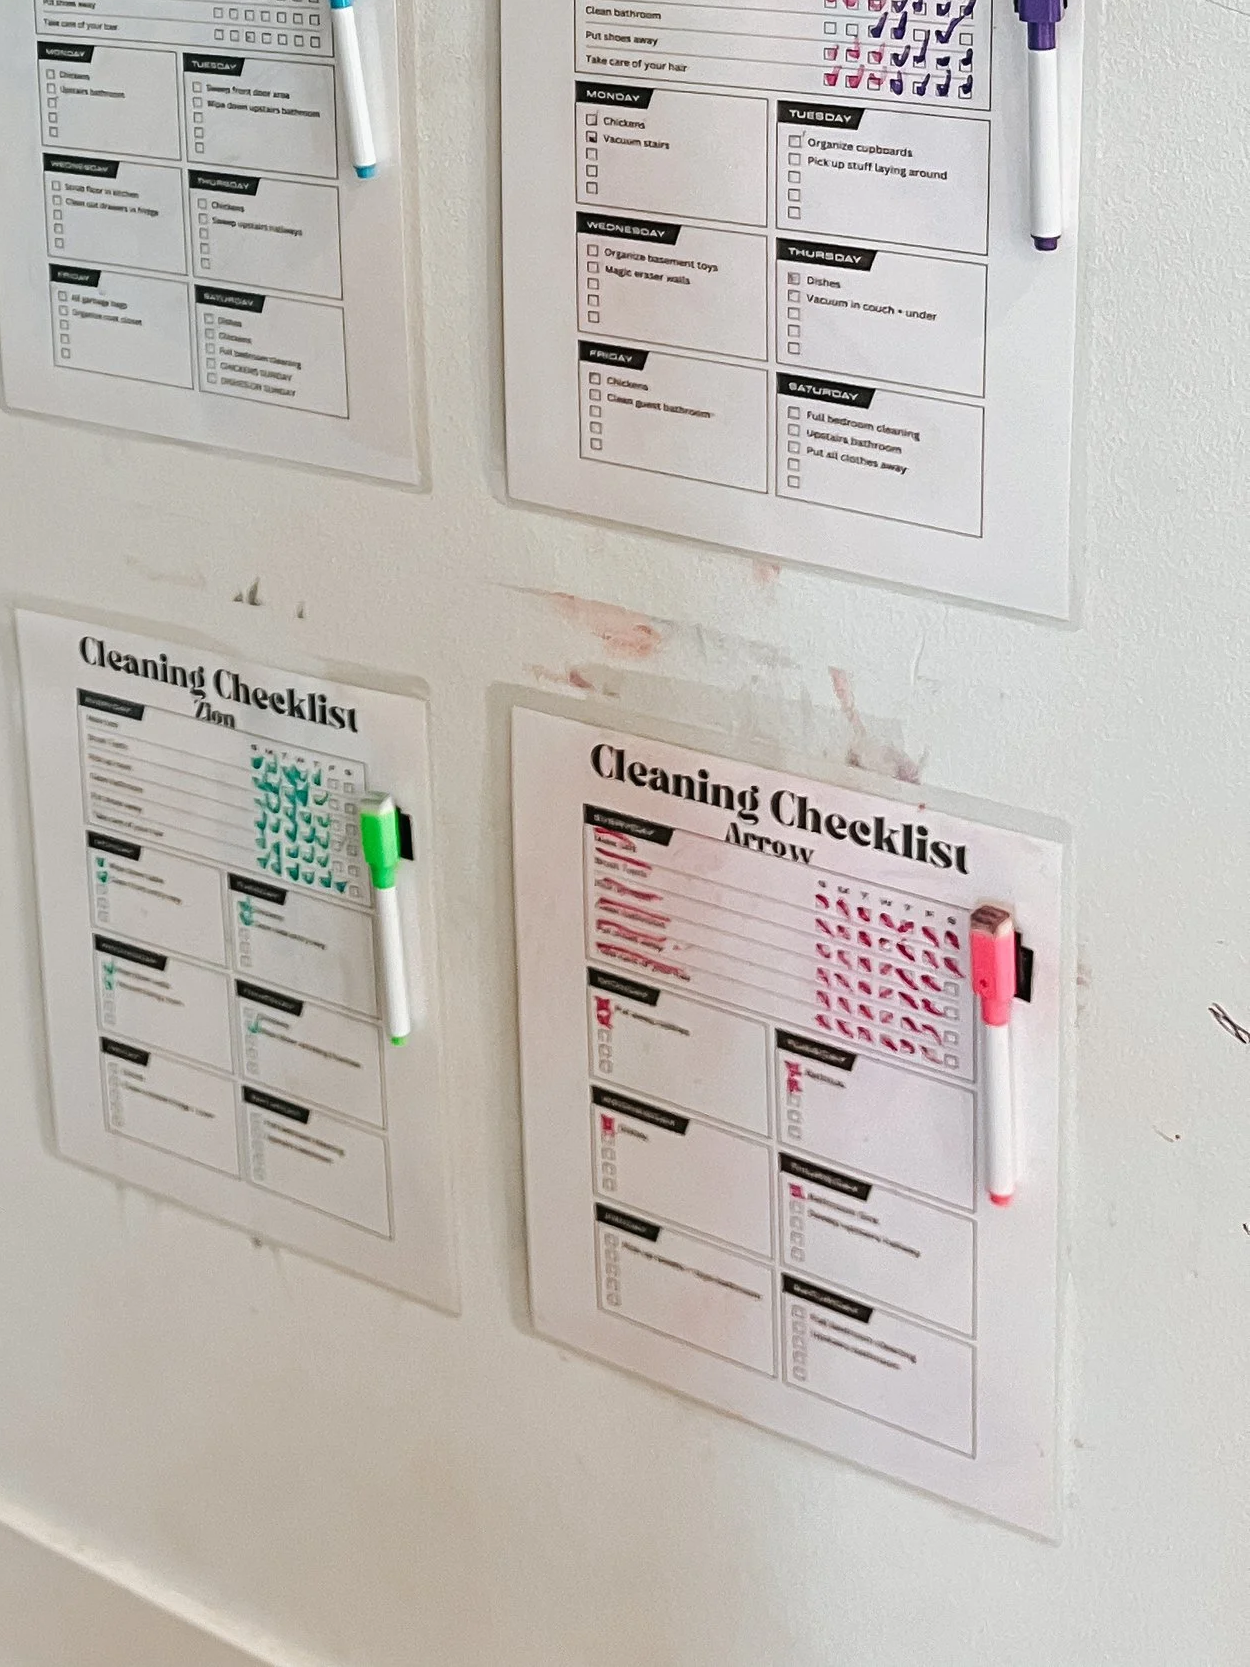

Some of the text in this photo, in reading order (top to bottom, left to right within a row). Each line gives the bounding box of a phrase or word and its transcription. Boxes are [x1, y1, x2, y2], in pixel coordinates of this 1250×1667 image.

[586, 89, 639, 101] MONDAY
[788, 108, 851, 122] TUESDAY
[787, 246, 861, 263] THURSDAY
[78, 635, 360, 733] Cleaning Checklist
[193, 696, 237, 729] Zion
[590, 742, 970, 875] Cleaning Checklist
[723, 821, 816, 866] Arrow
